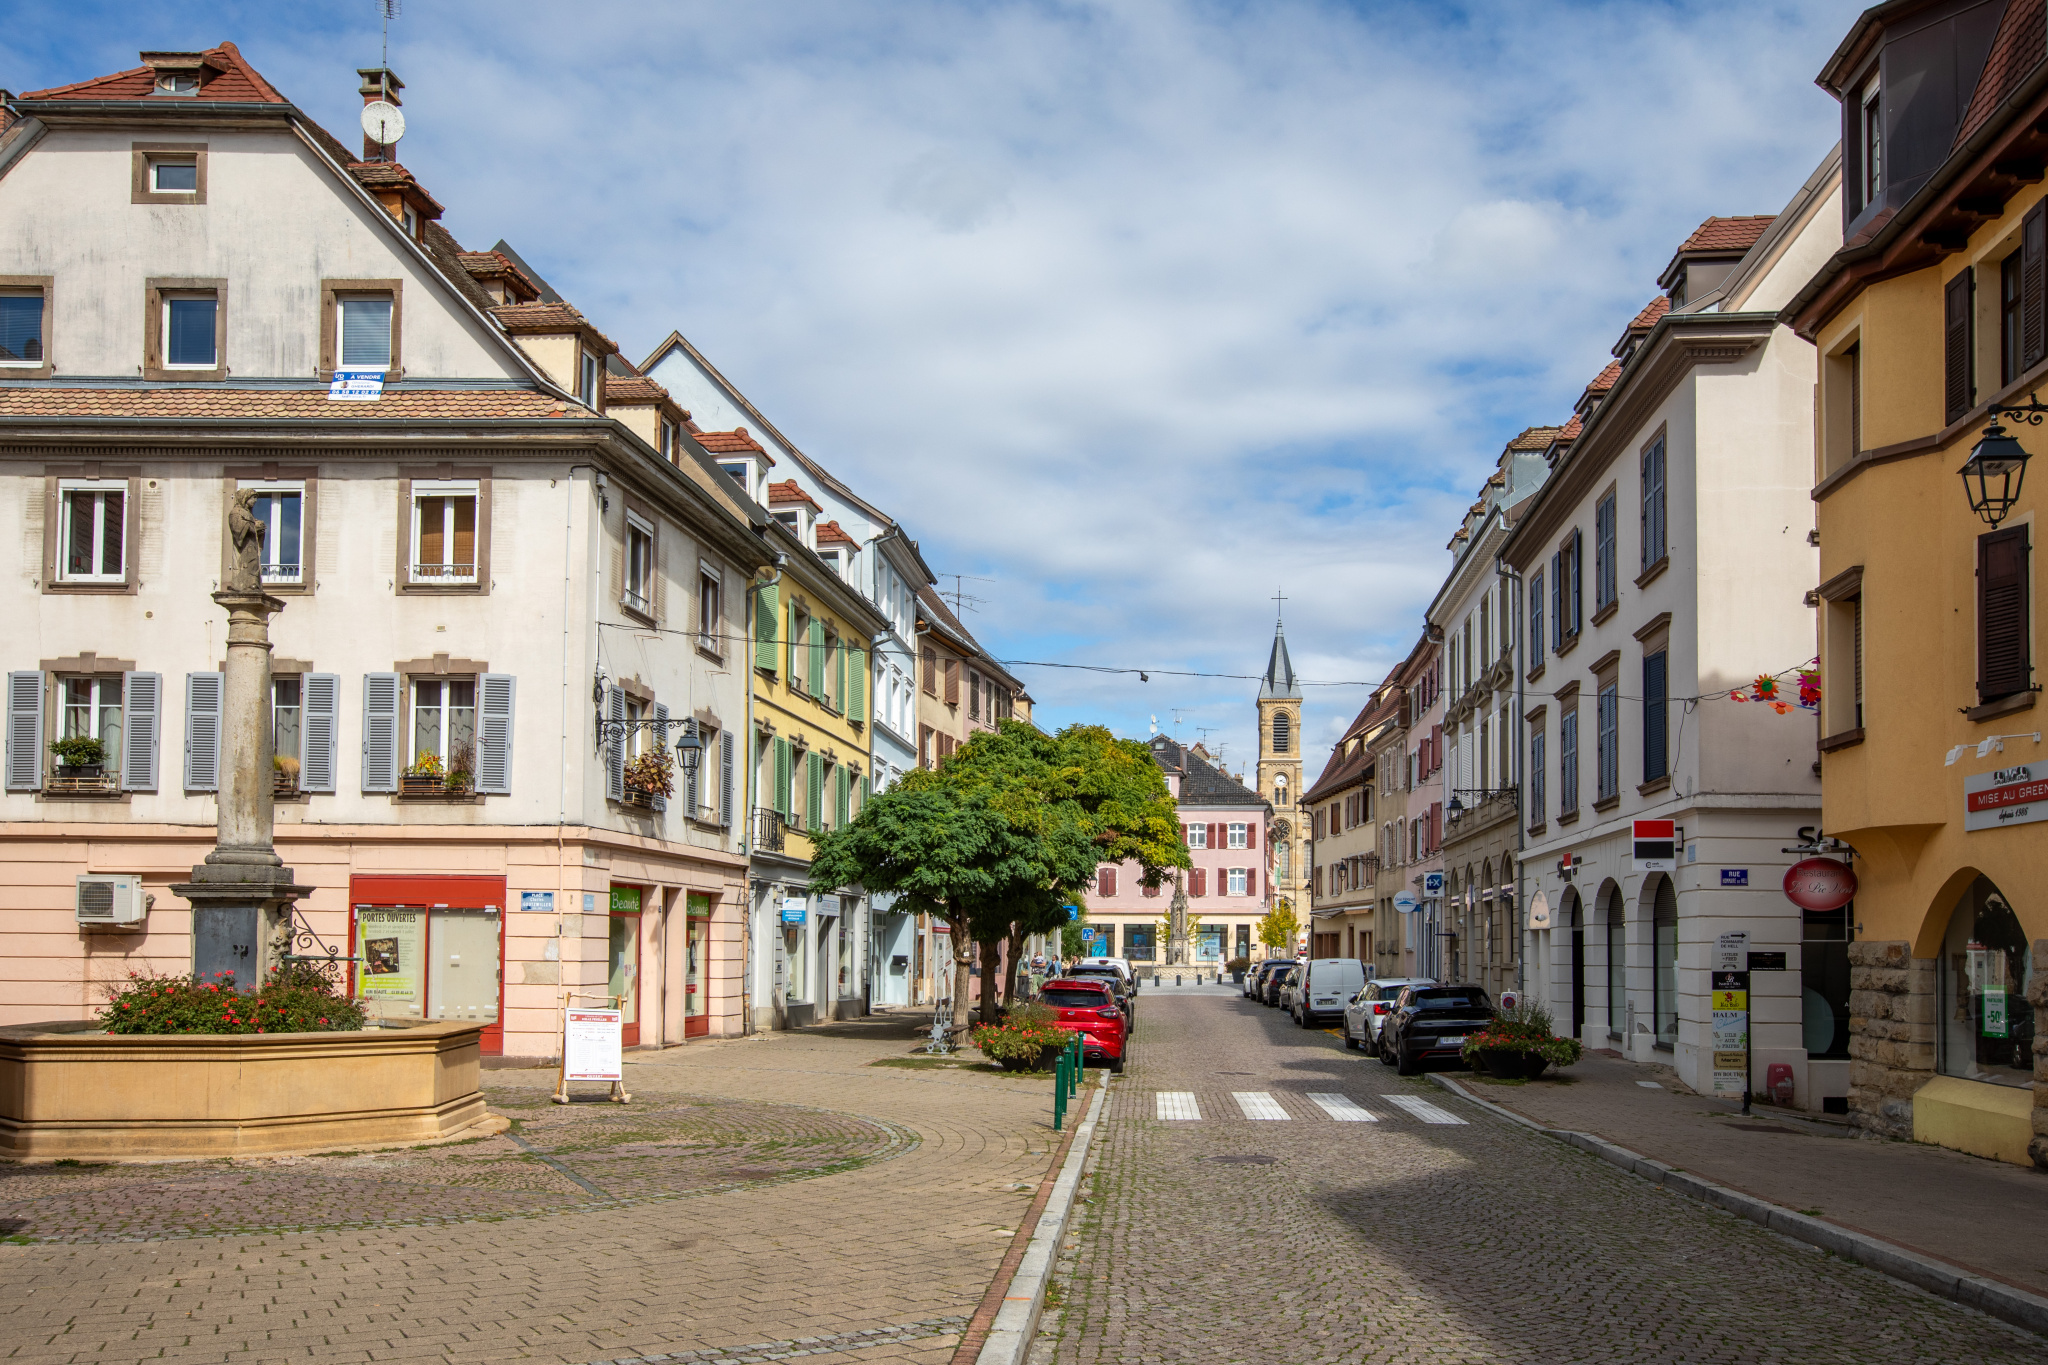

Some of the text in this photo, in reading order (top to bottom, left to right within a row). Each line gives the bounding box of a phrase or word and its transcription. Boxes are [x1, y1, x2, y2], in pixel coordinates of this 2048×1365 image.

[1978, 792, 2000, 805] MISE
[2002, 790, 2016, 800] AU
[1796, 868, 1844, 878] Restaurant
[1808, 882, 1827, 894] Pic
[612, 892, 640, 910] Beauté
[686, 899, 708, 915] Beauté
[362, 912, 416, 922] PORTES OUVERTES
